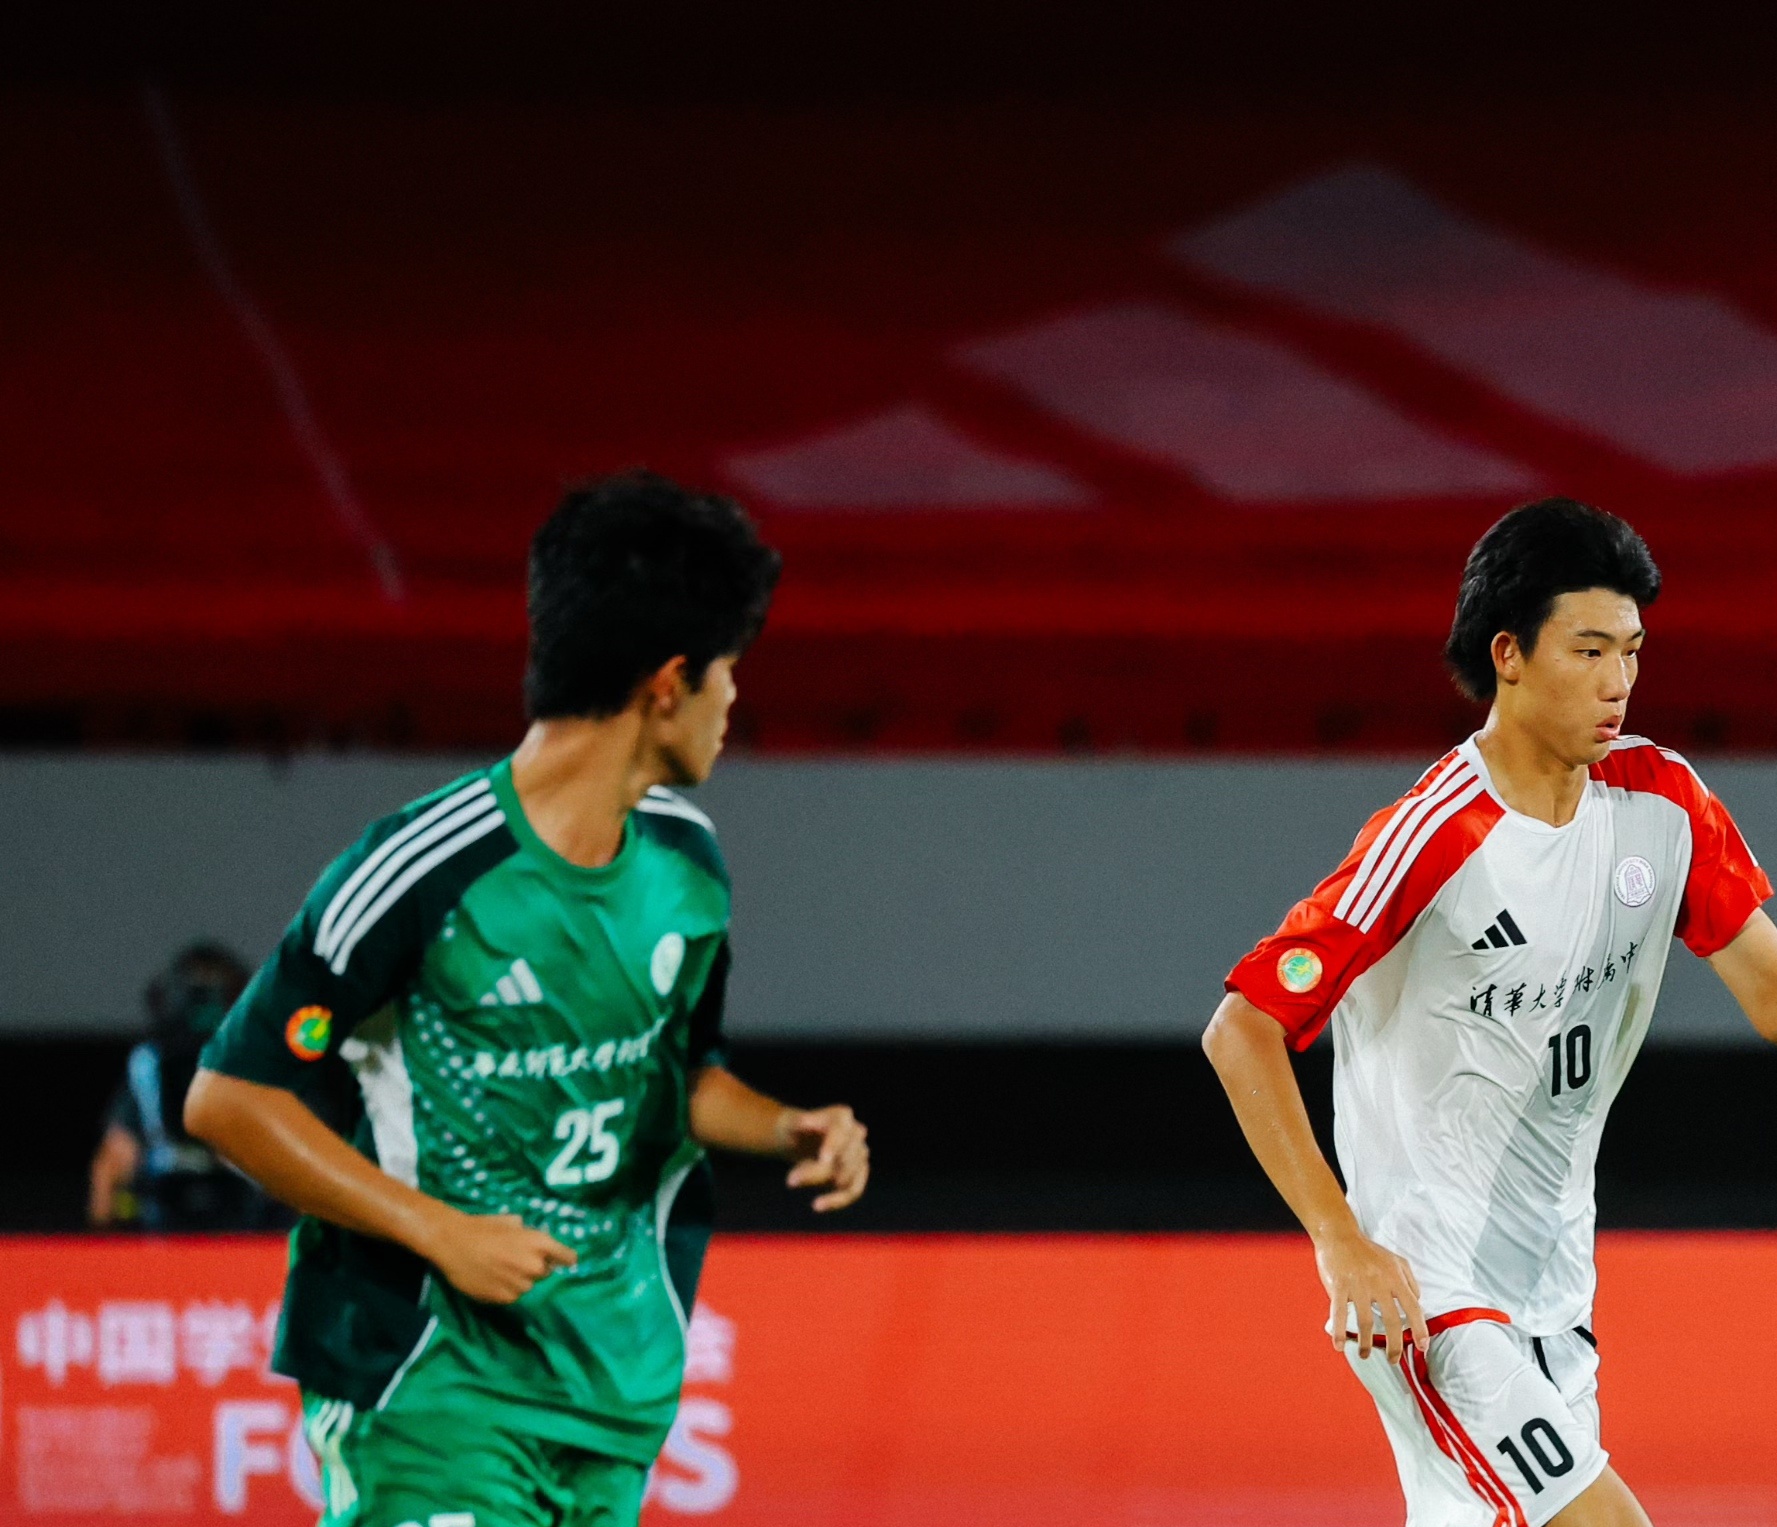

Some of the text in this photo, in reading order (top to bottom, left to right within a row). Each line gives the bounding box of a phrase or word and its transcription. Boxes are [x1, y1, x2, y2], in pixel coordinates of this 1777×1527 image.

[1548, 1024, 1591, 1097] 10
[546, 1098, 625, 1186] 25
[1496, 1418, 1574, 1495] 10
